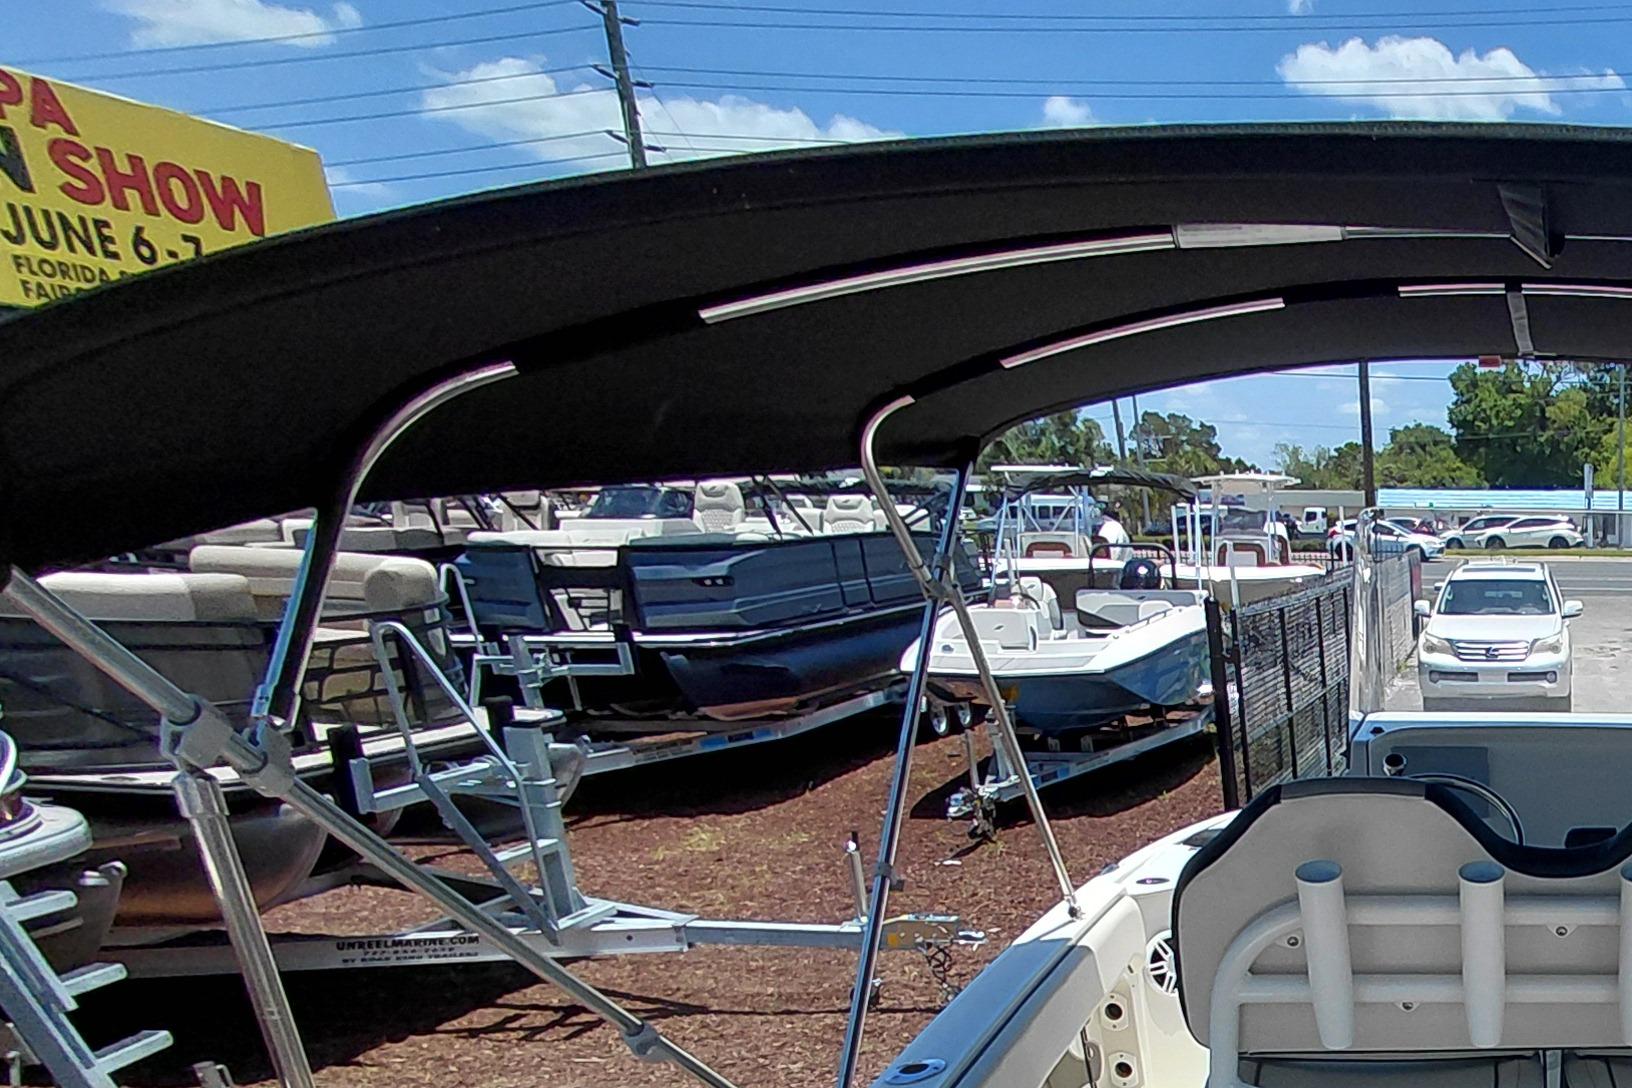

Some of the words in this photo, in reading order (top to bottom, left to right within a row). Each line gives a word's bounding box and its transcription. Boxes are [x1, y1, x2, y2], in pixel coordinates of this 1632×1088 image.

[48, 137, 265, 237] SHOW
[0, 202, 121, 261] JUNE
[12, 254, 111, 284] FLORIDA
[336, 936, 479, 950] UNREELMARINE.COM
